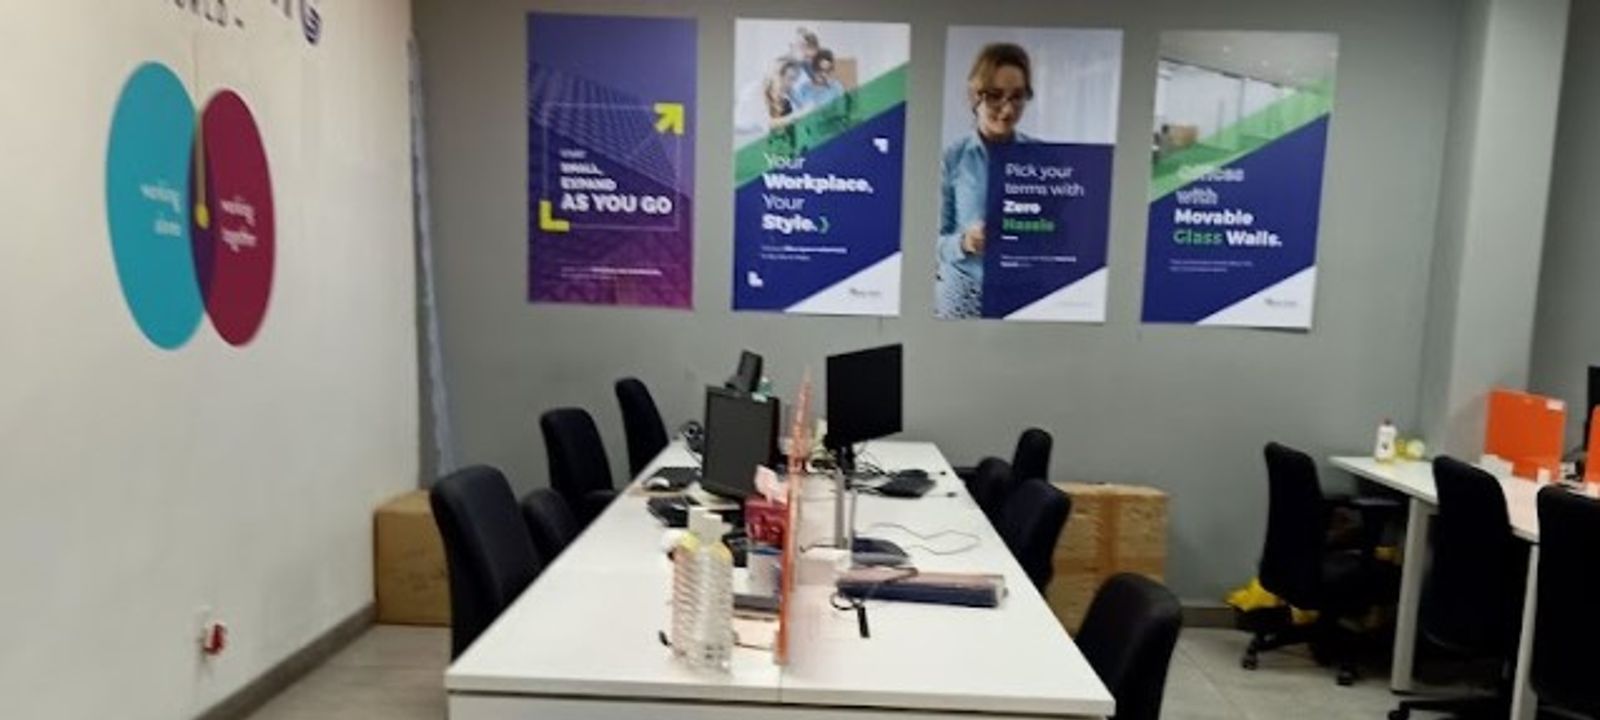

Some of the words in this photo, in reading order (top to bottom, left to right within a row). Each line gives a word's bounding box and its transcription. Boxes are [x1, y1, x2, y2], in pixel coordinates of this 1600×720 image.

[763, 153, 806, 169] Your
[1005, 163, 1037, 177] Pick
[1039, 166, 1073, 180] your
[762, 173, 874, 194] Workplace,
[1005, 183, 1048, 195] terms
[1050, 183, 1084, 196] with
[561, 193, 589, 212] AS
[591, 193, 637, 212] YOU
[641, 195, 672, 214] GO
[762, 194, 806, 209] Your
[1176, 187, 1218, 205] with
[1003, 201, 1041, 214] Zero
[762, 213, 818, 234] Style.
[1174, 209, 1254, 225] Movable
[1173, 229, 1222, 245] Glass
[1226, 230, 1282, 247] Walls.
